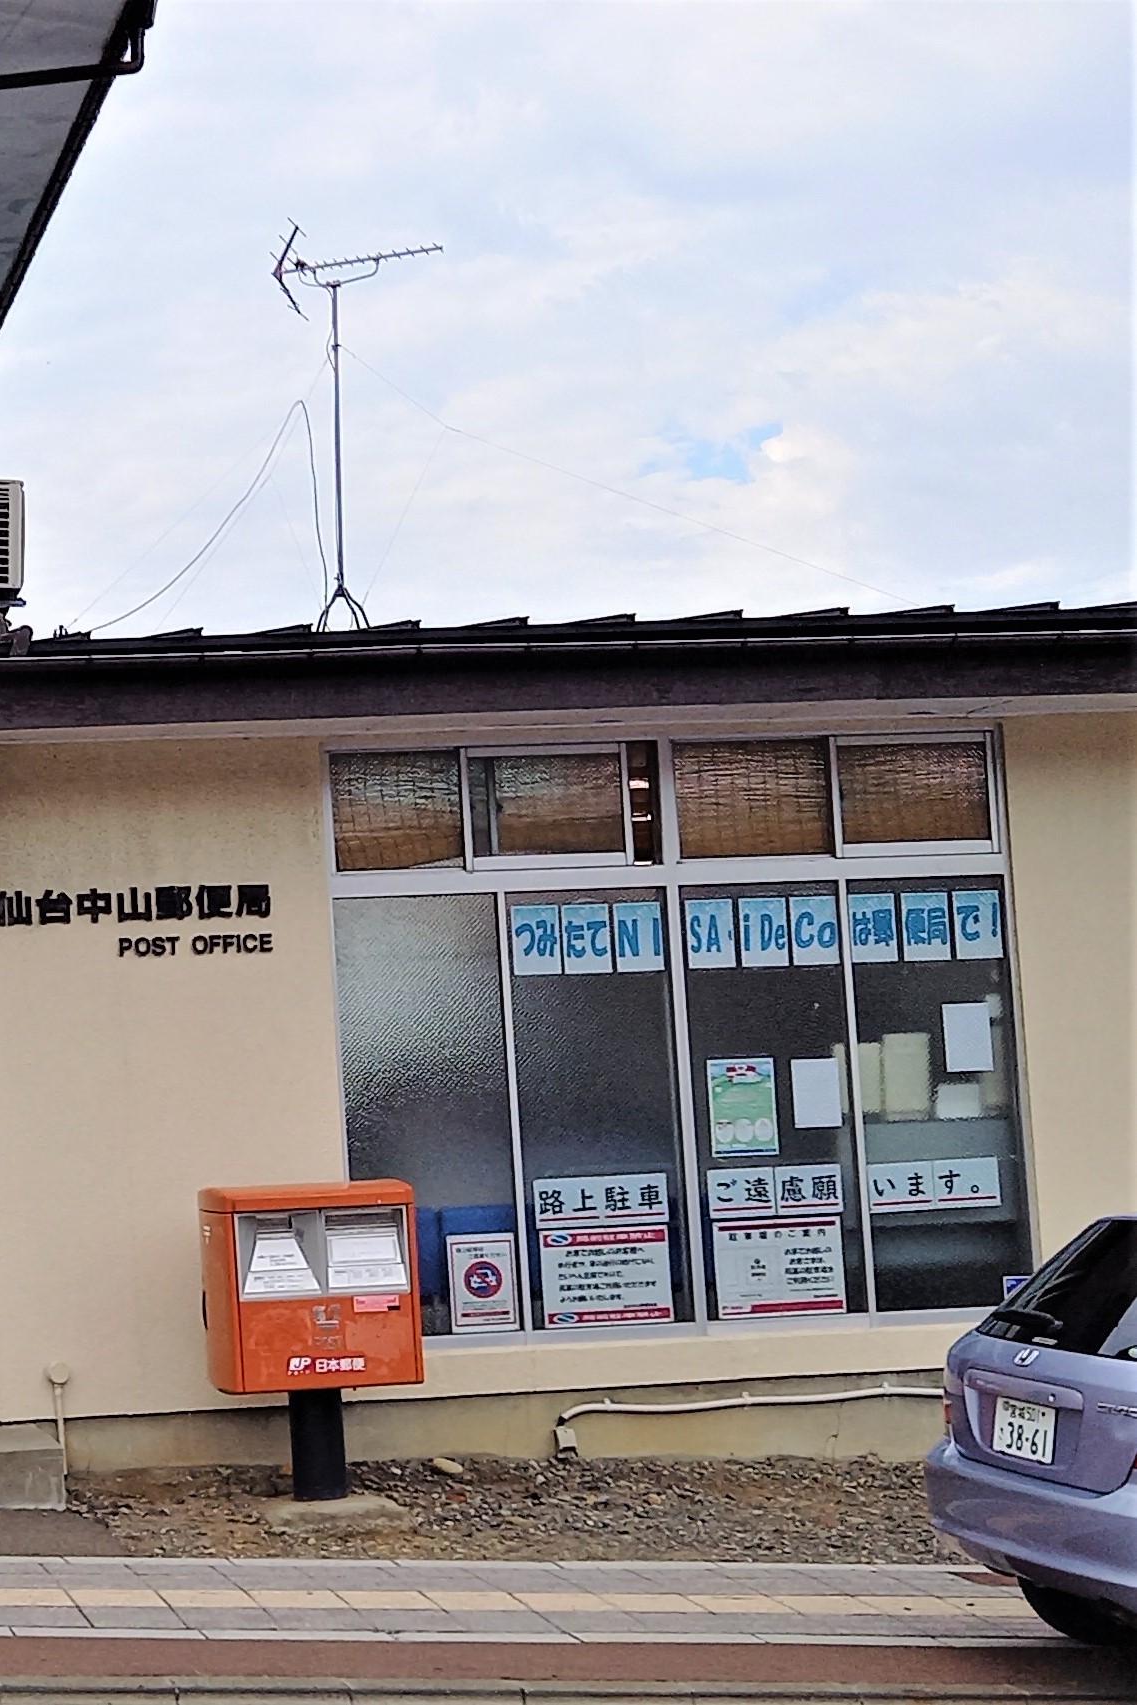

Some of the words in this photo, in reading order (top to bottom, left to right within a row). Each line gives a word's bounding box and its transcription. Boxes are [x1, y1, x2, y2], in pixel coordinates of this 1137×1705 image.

[117, 935, 181, 957] POST
[192, 933, 274, 955] OFFICE
[538, 1183, 664, 1216] 路上駐車
[715, 1173, 839, 1205] ご遠慮願
[872, 1169, 980, 1198] います。
[315, 1356, 366, 1372] 日本郵便
